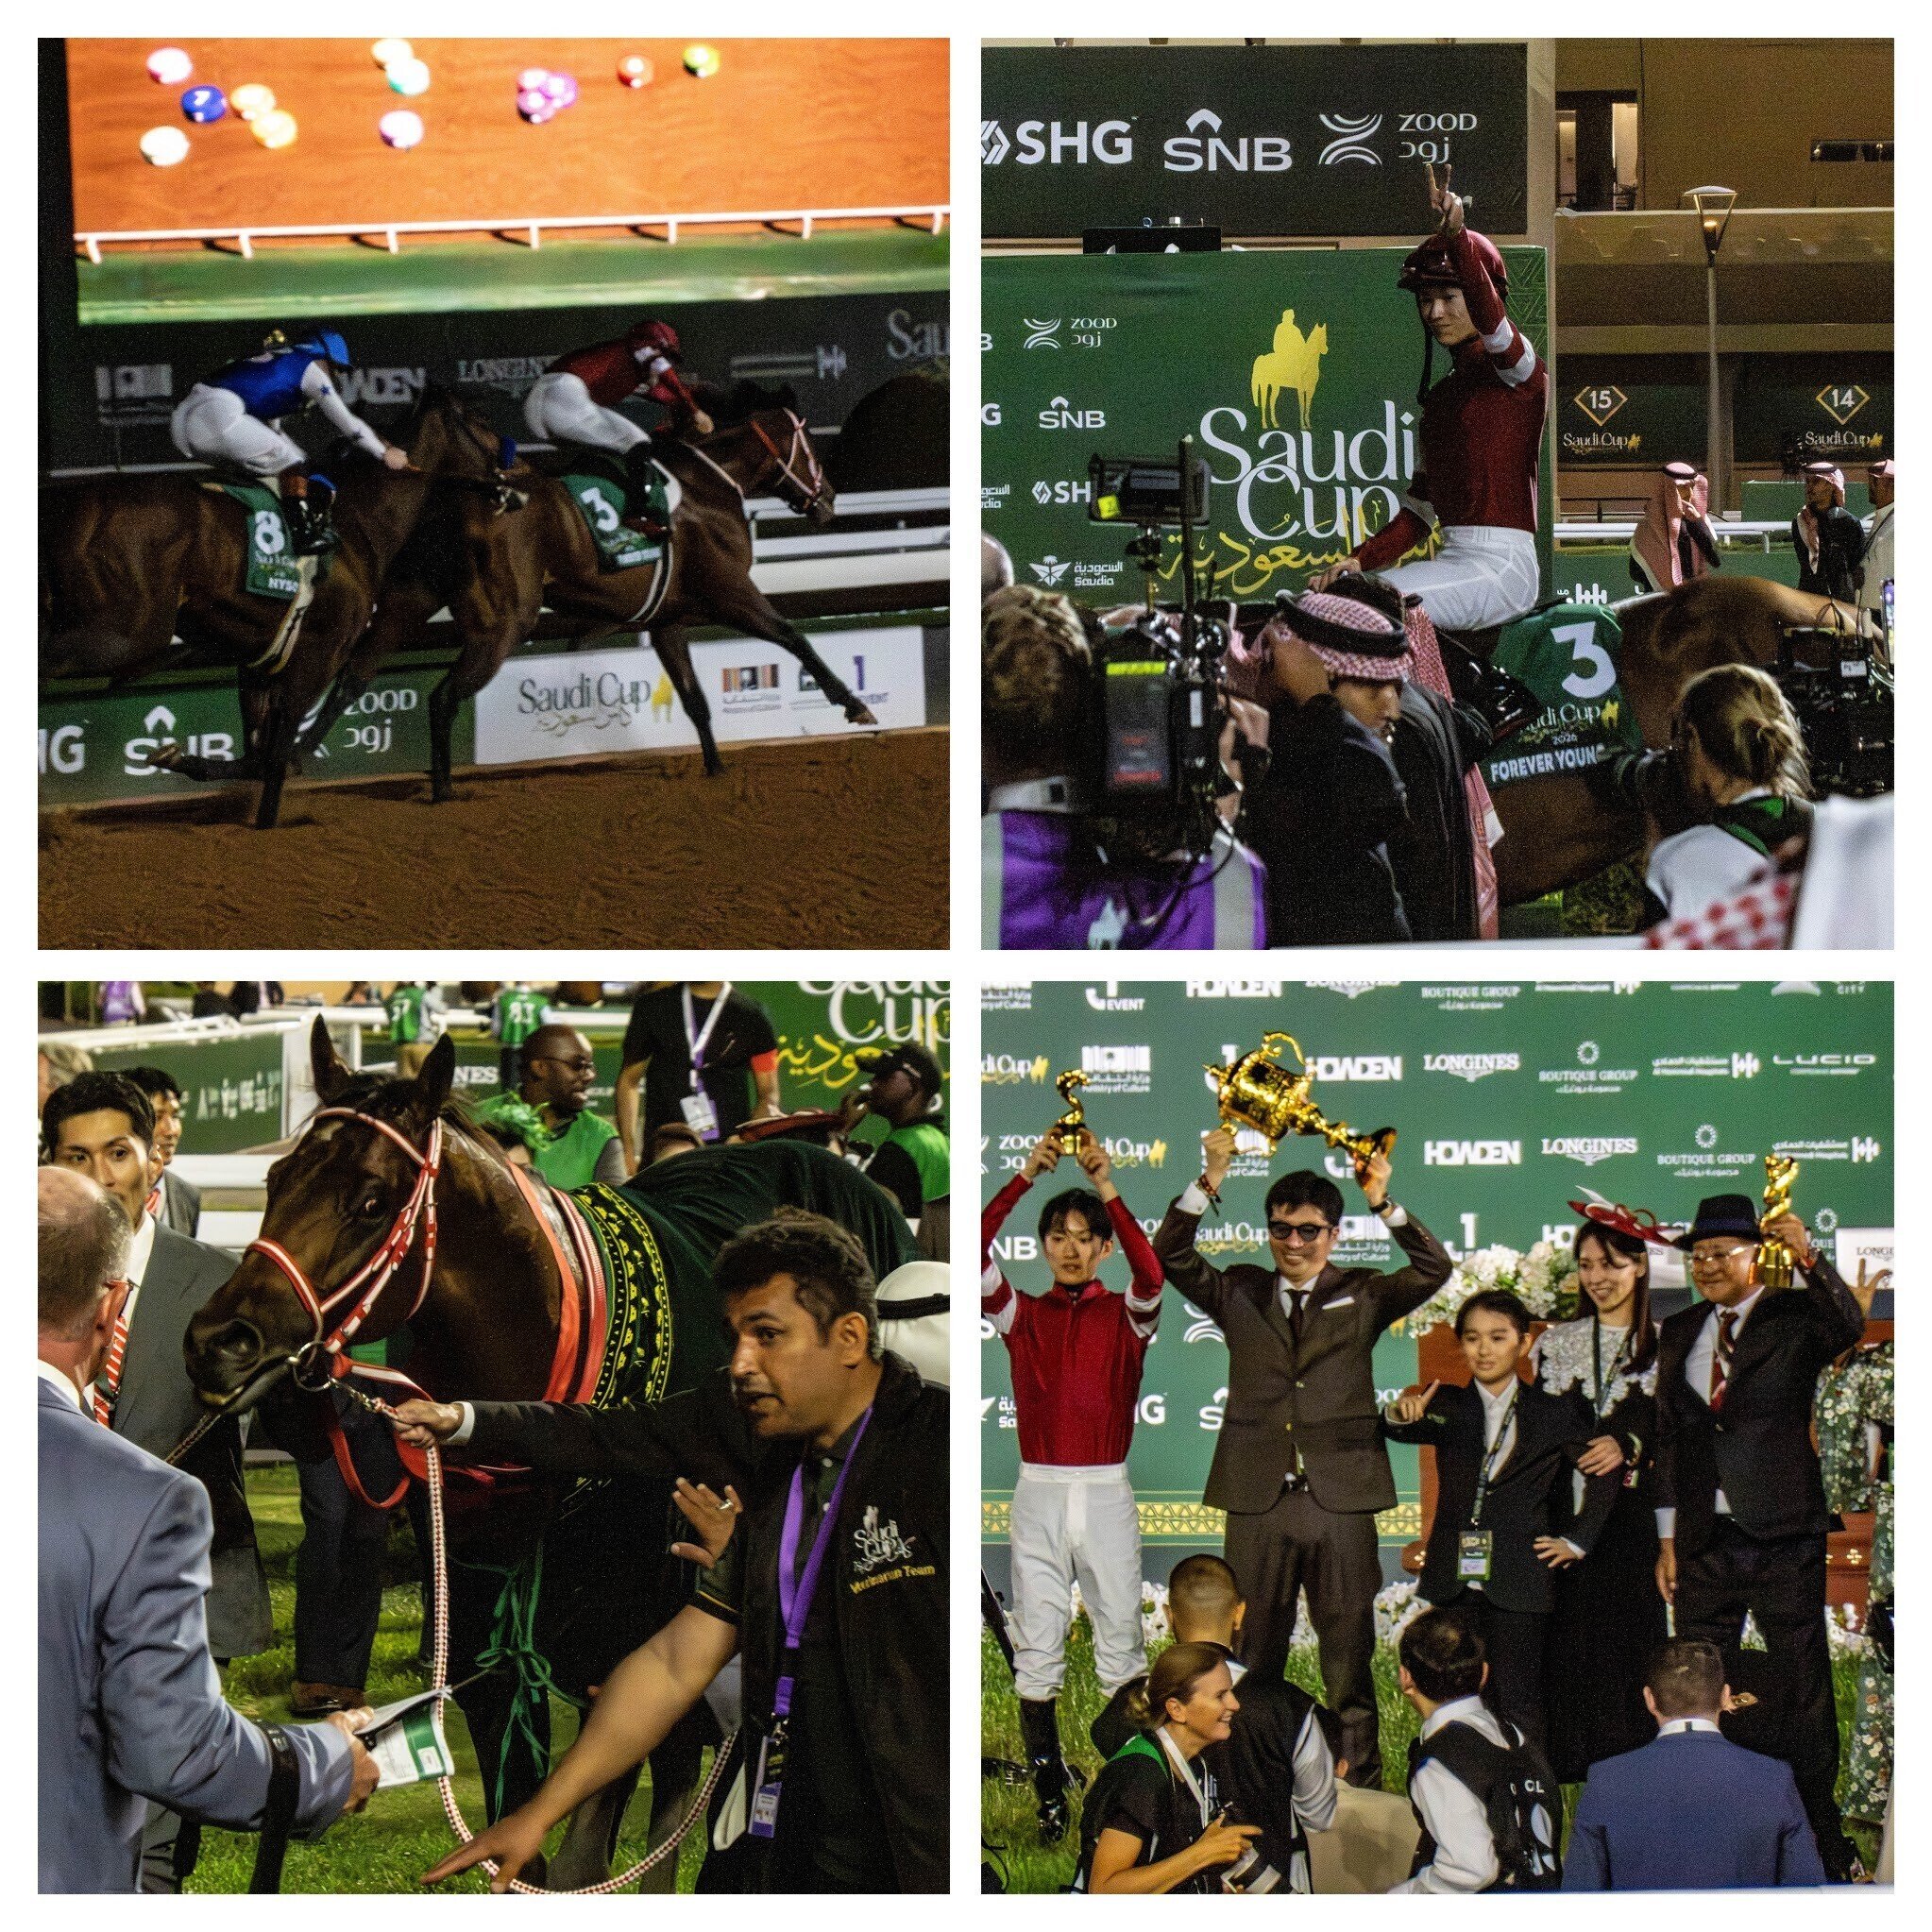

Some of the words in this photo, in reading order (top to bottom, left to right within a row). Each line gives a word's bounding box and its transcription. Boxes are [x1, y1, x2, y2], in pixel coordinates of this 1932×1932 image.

[1398, 113, 1478, 132] ZOOD
[1015, 120, 1133, 164] SHG
[1163, 137, 1294, 172] SNB
[1071, 317, 1117, 330] ZOOD
[1588, 390, 1613, 410] 15
[1830, 389, 1856, 409] 14
[1039, 411, 1106, 429] SNB
[1200, 399, 1415, 484] Saudi
[1563, 432, 1600, 448] Saudi
[1602, 432, 1629, 450] Cup
[1805, 431, 1841, 447] Saudi
[1842, 432, 1871, 449] Cup
[580, 486, 620, 532] 3
[1236, 463, 1401, 548] Cup
[254, 510, 285, 555] 8
[1550, 620, 1618, 700] 3
[518, 672, 591, 715] Saudi
[596, 671, 652, 714] Cup
[1559, 703, 1602, 728] Cup
[1490, 753, 1556, 784] FOREVER
[1107, 997, 1145, 1010] EVENT
[1482, 986, 1521, 998] GROUP
[997, 1054, 1032, 1078] Cup
[1305, 1056, 1403, 1081] HOWDEN
[1423, 1053, 1520, 1071] LONGINES
[1538, 1070, 1596, 1082] BOUTIQUE
[1598, 1069, 1639, 1082] GROUP
[1114, 1138, 1151, 1162] Cup
[1424, 1139, 1522, 1165] HOWDEN
[1541, 1138, 1639, 1154] LONGINES
[1656, 1154, 1715, 1166] BOUTIQUE
[1717, 1153, 1756, 1165] GROUP
[1234, 1222, 1269, 1246] Cup
